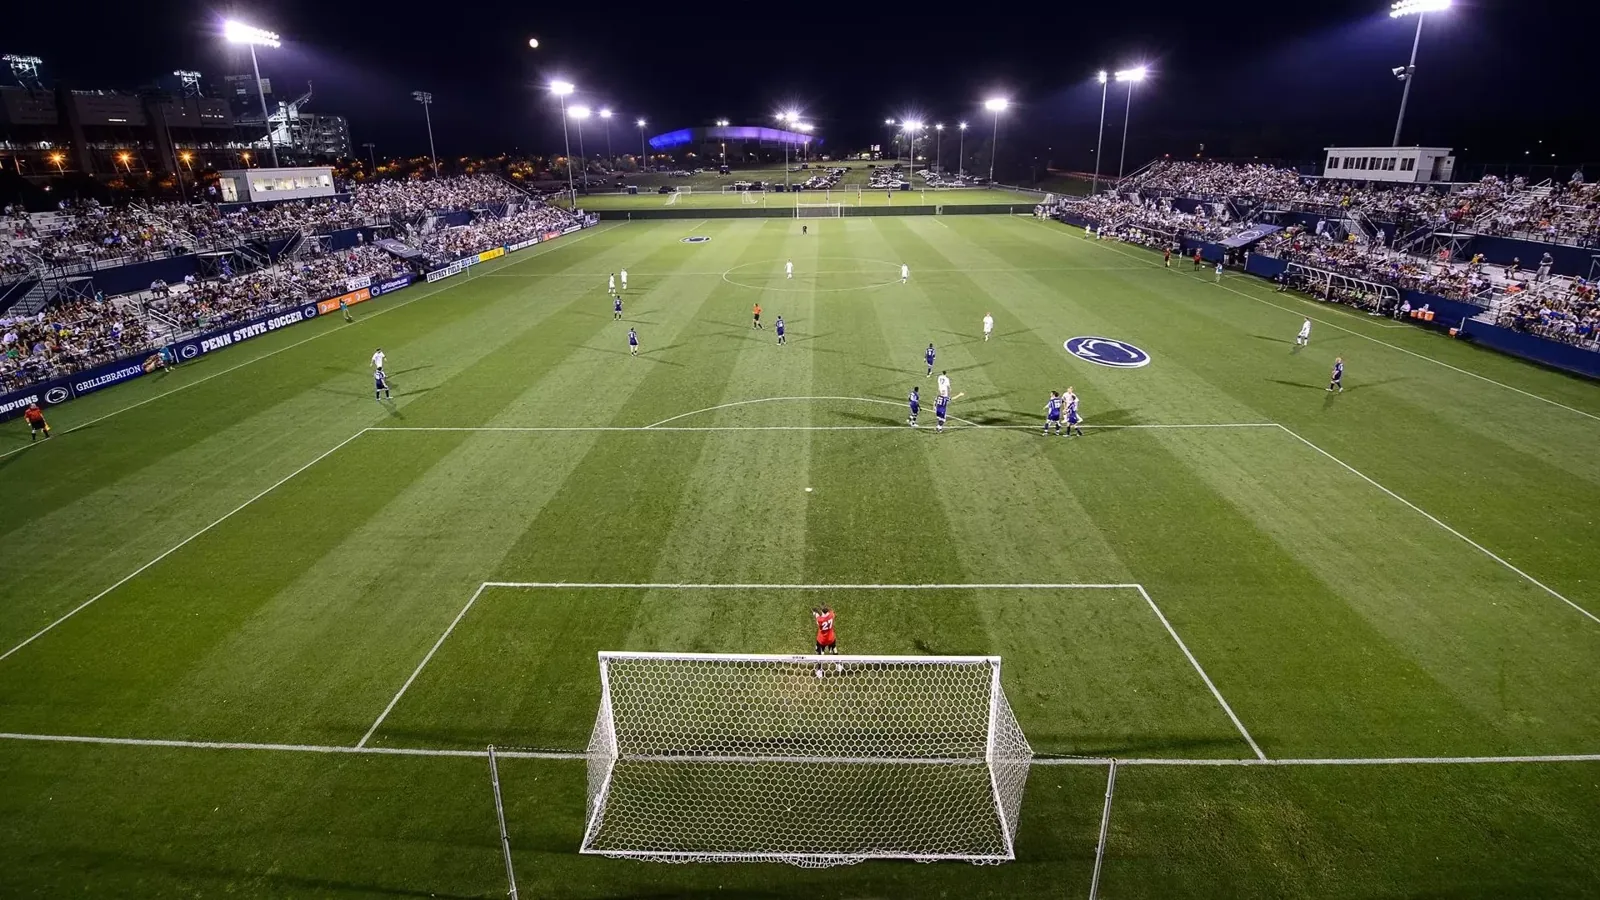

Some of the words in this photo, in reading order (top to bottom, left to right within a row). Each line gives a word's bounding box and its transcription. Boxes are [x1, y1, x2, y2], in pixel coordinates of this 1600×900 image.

[201, 333, 232, 353] PENN
[233, 321, 267, 342] STATE
[267, 311, 303, 330] SOCCER
[75, 364, 142, 392] GRILLEBRATION
[822, 618, 833, 631] 27
